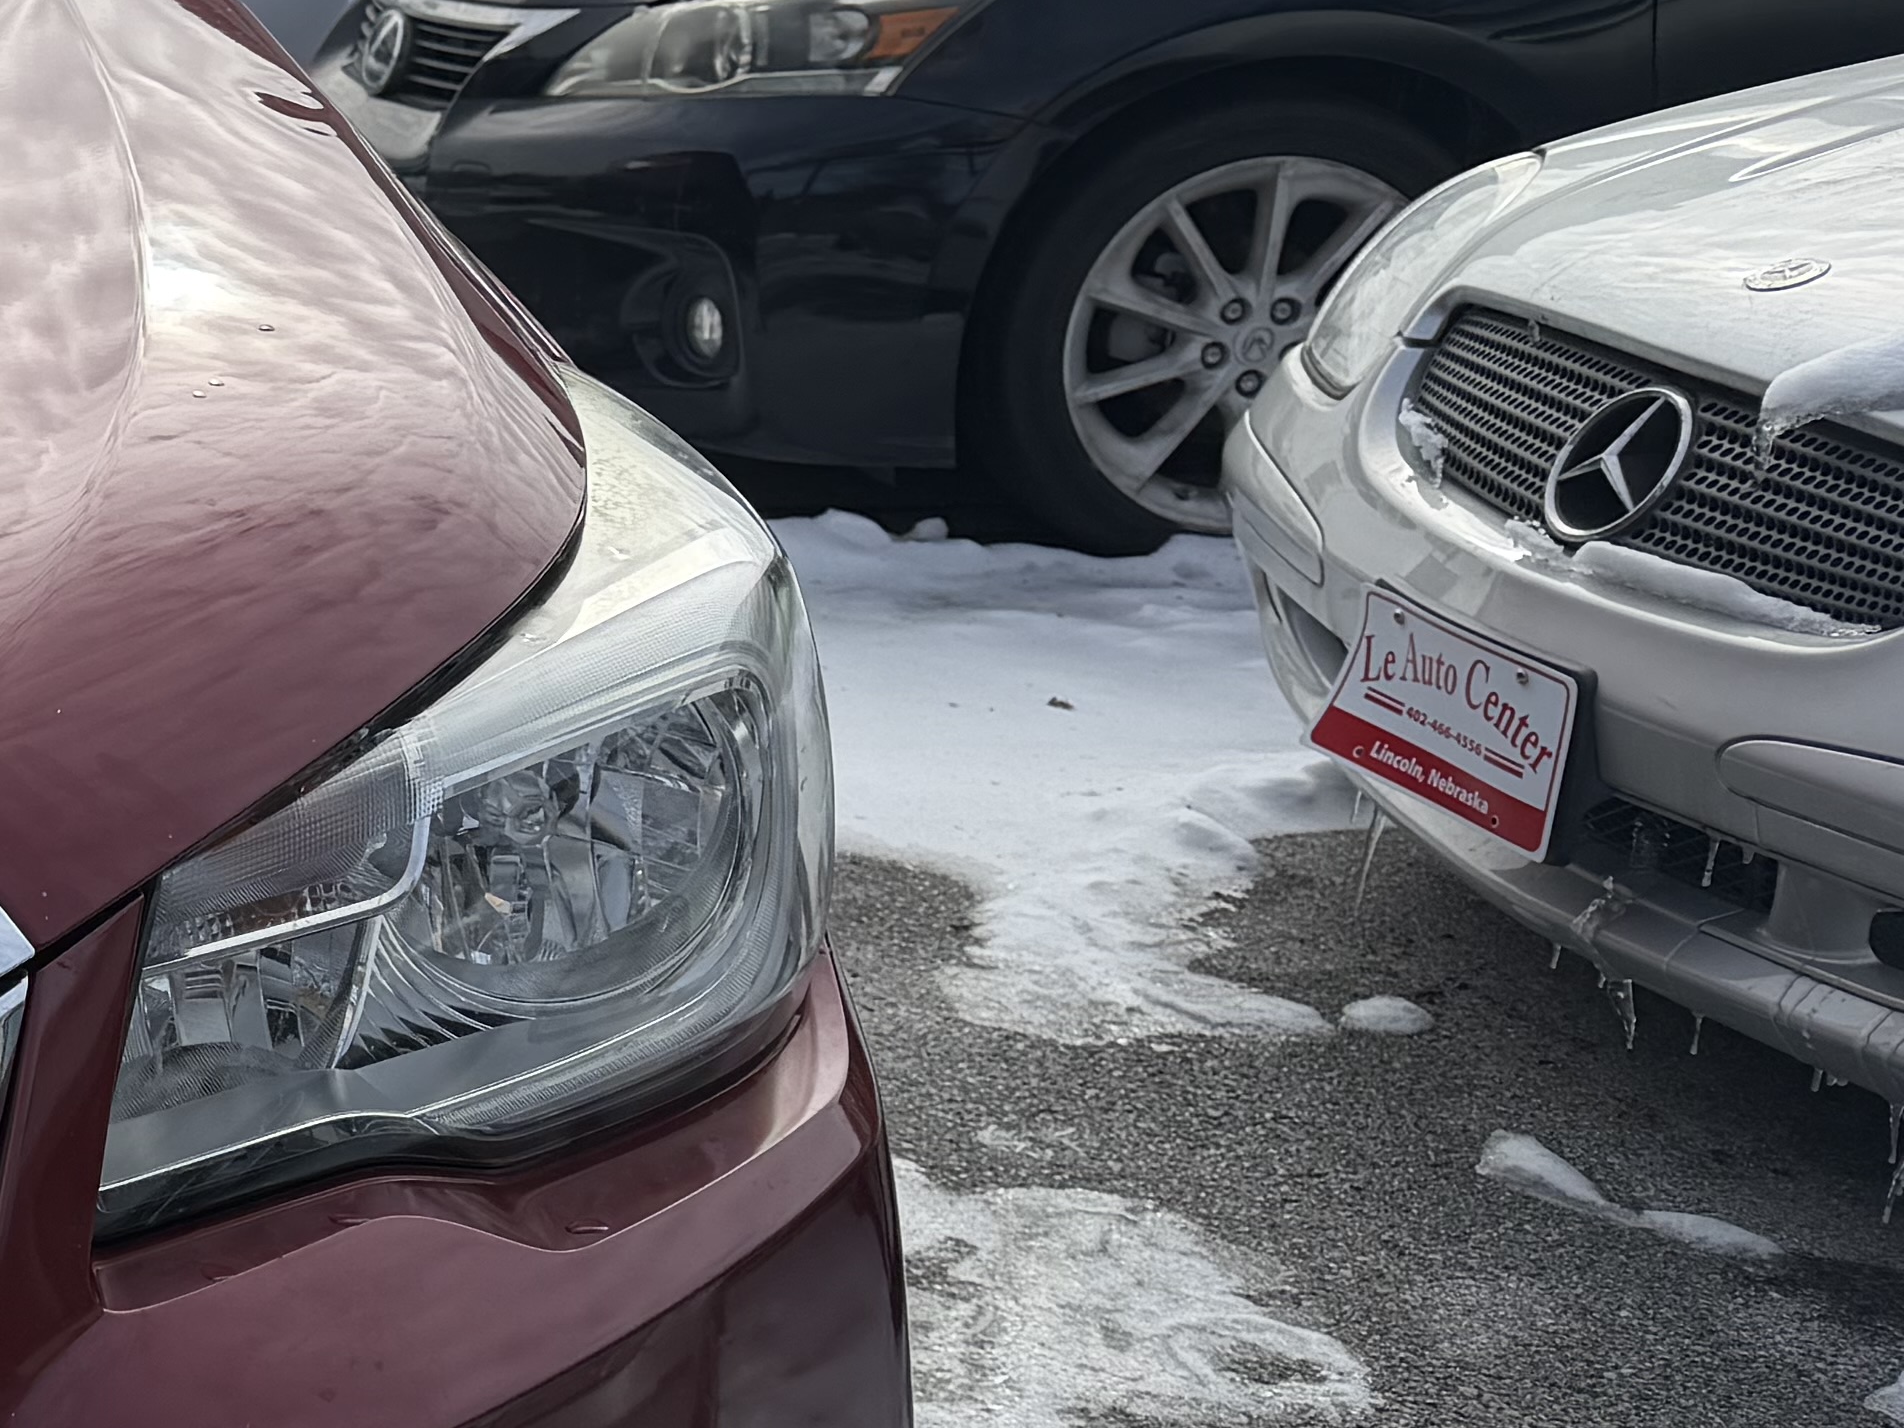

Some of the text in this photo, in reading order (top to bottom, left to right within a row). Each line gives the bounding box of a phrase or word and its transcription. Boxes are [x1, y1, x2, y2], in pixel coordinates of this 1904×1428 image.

[1359, 632, 1554, 775] Le Auto Center
[1405, 706, 1483, 757] 402-466-4556
[1368, 740, 1490, 815] Lincoln, Nebraska
